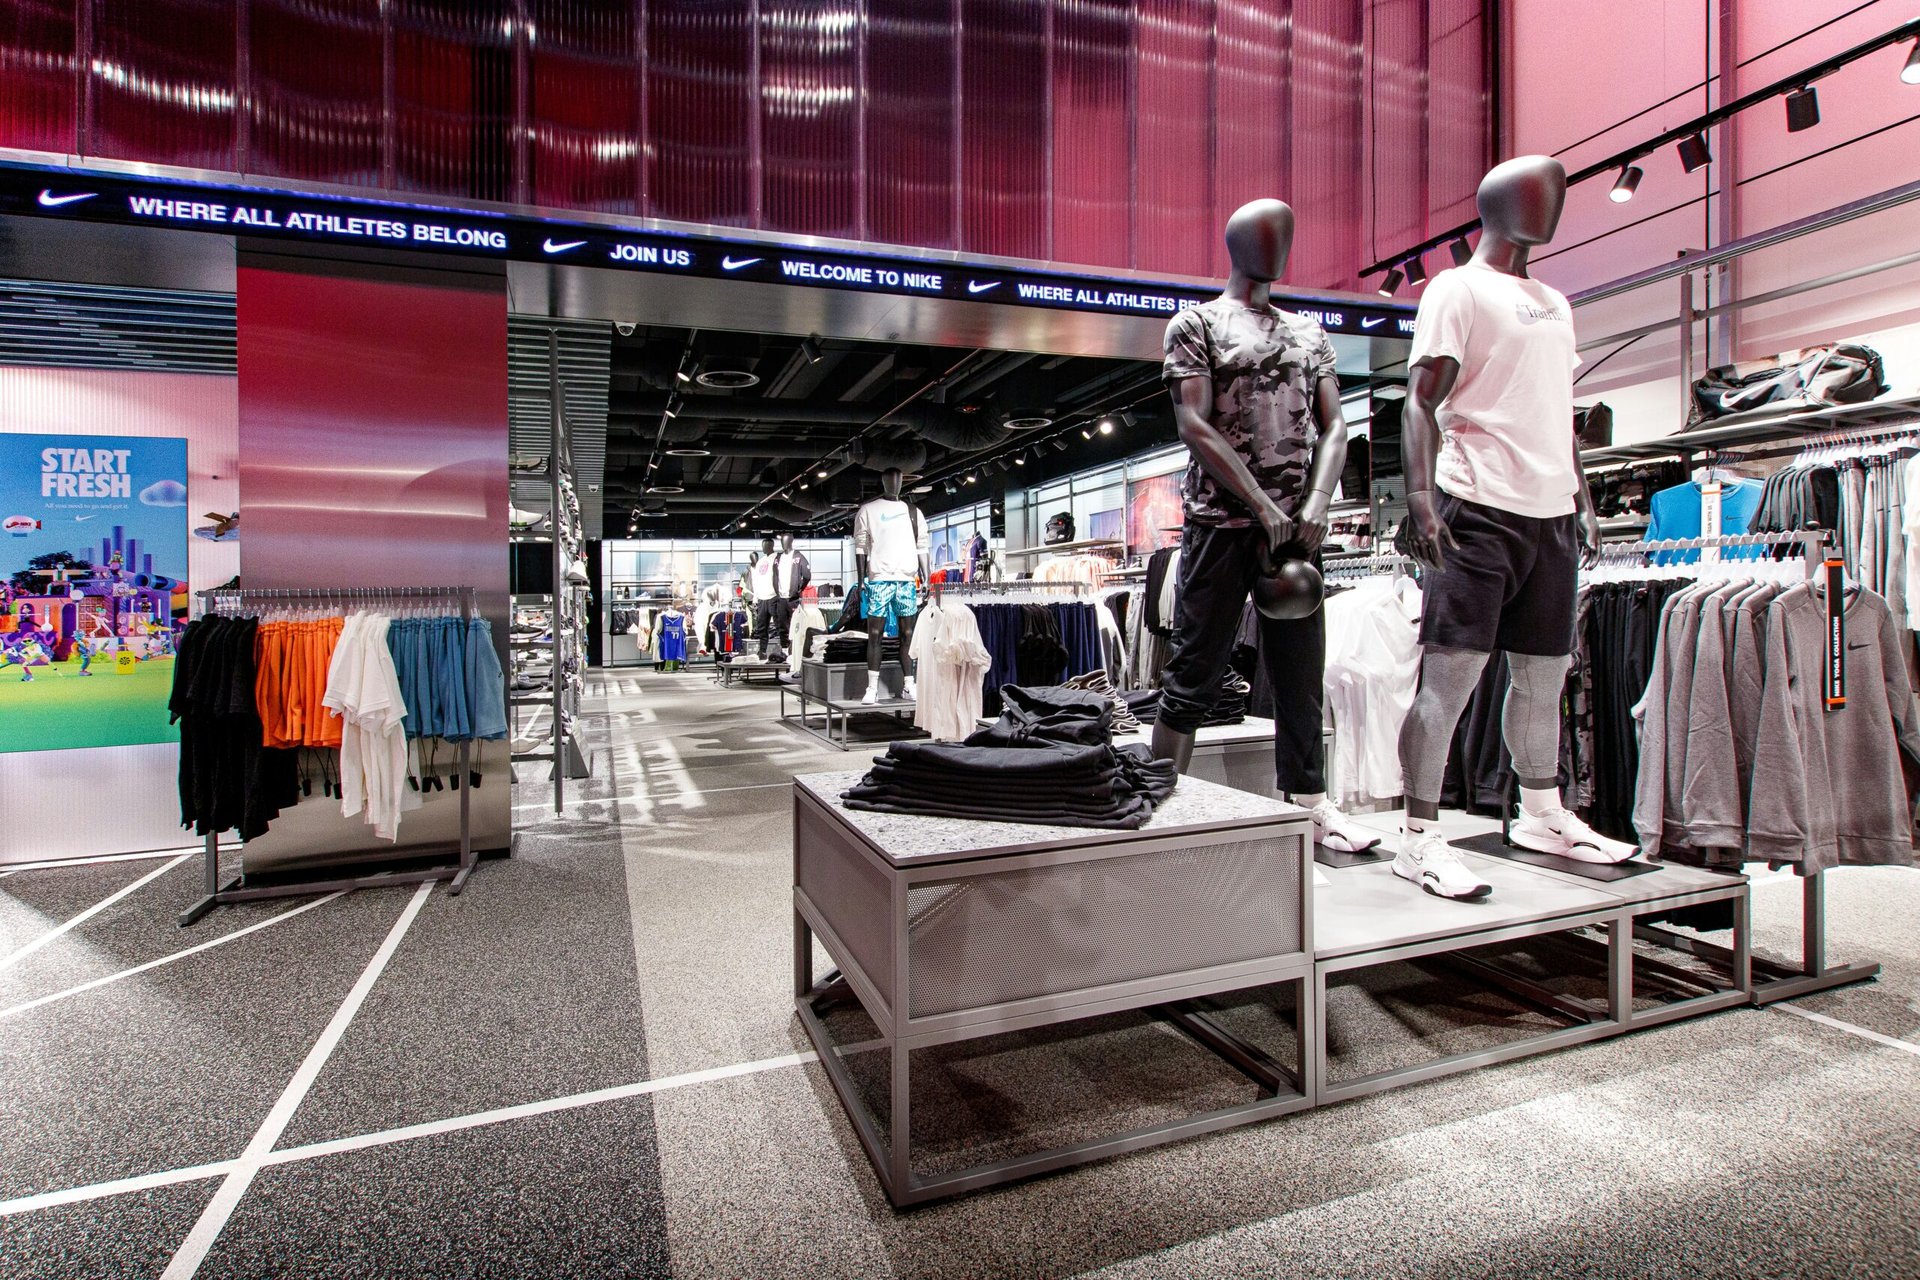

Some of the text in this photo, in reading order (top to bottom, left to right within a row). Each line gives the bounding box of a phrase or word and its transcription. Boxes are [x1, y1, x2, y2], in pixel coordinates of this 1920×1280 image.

[128, 196, 507, 249] WHERE ALL ATHLETES BELONG
[610, 244, 690, 266] JOIN US
[781, 260, 942, 290] WELCOME TO NIKE
[1018, 284, 1073, 302] WHERE
[1076, 289, 1103, 305] ALL
[1106, 292, 1176, 311] ATHLETES
[1325, 312, 1343, 326] US
[41, 447, 131, 474] START
[41, 472, 131, 498] FRESH
